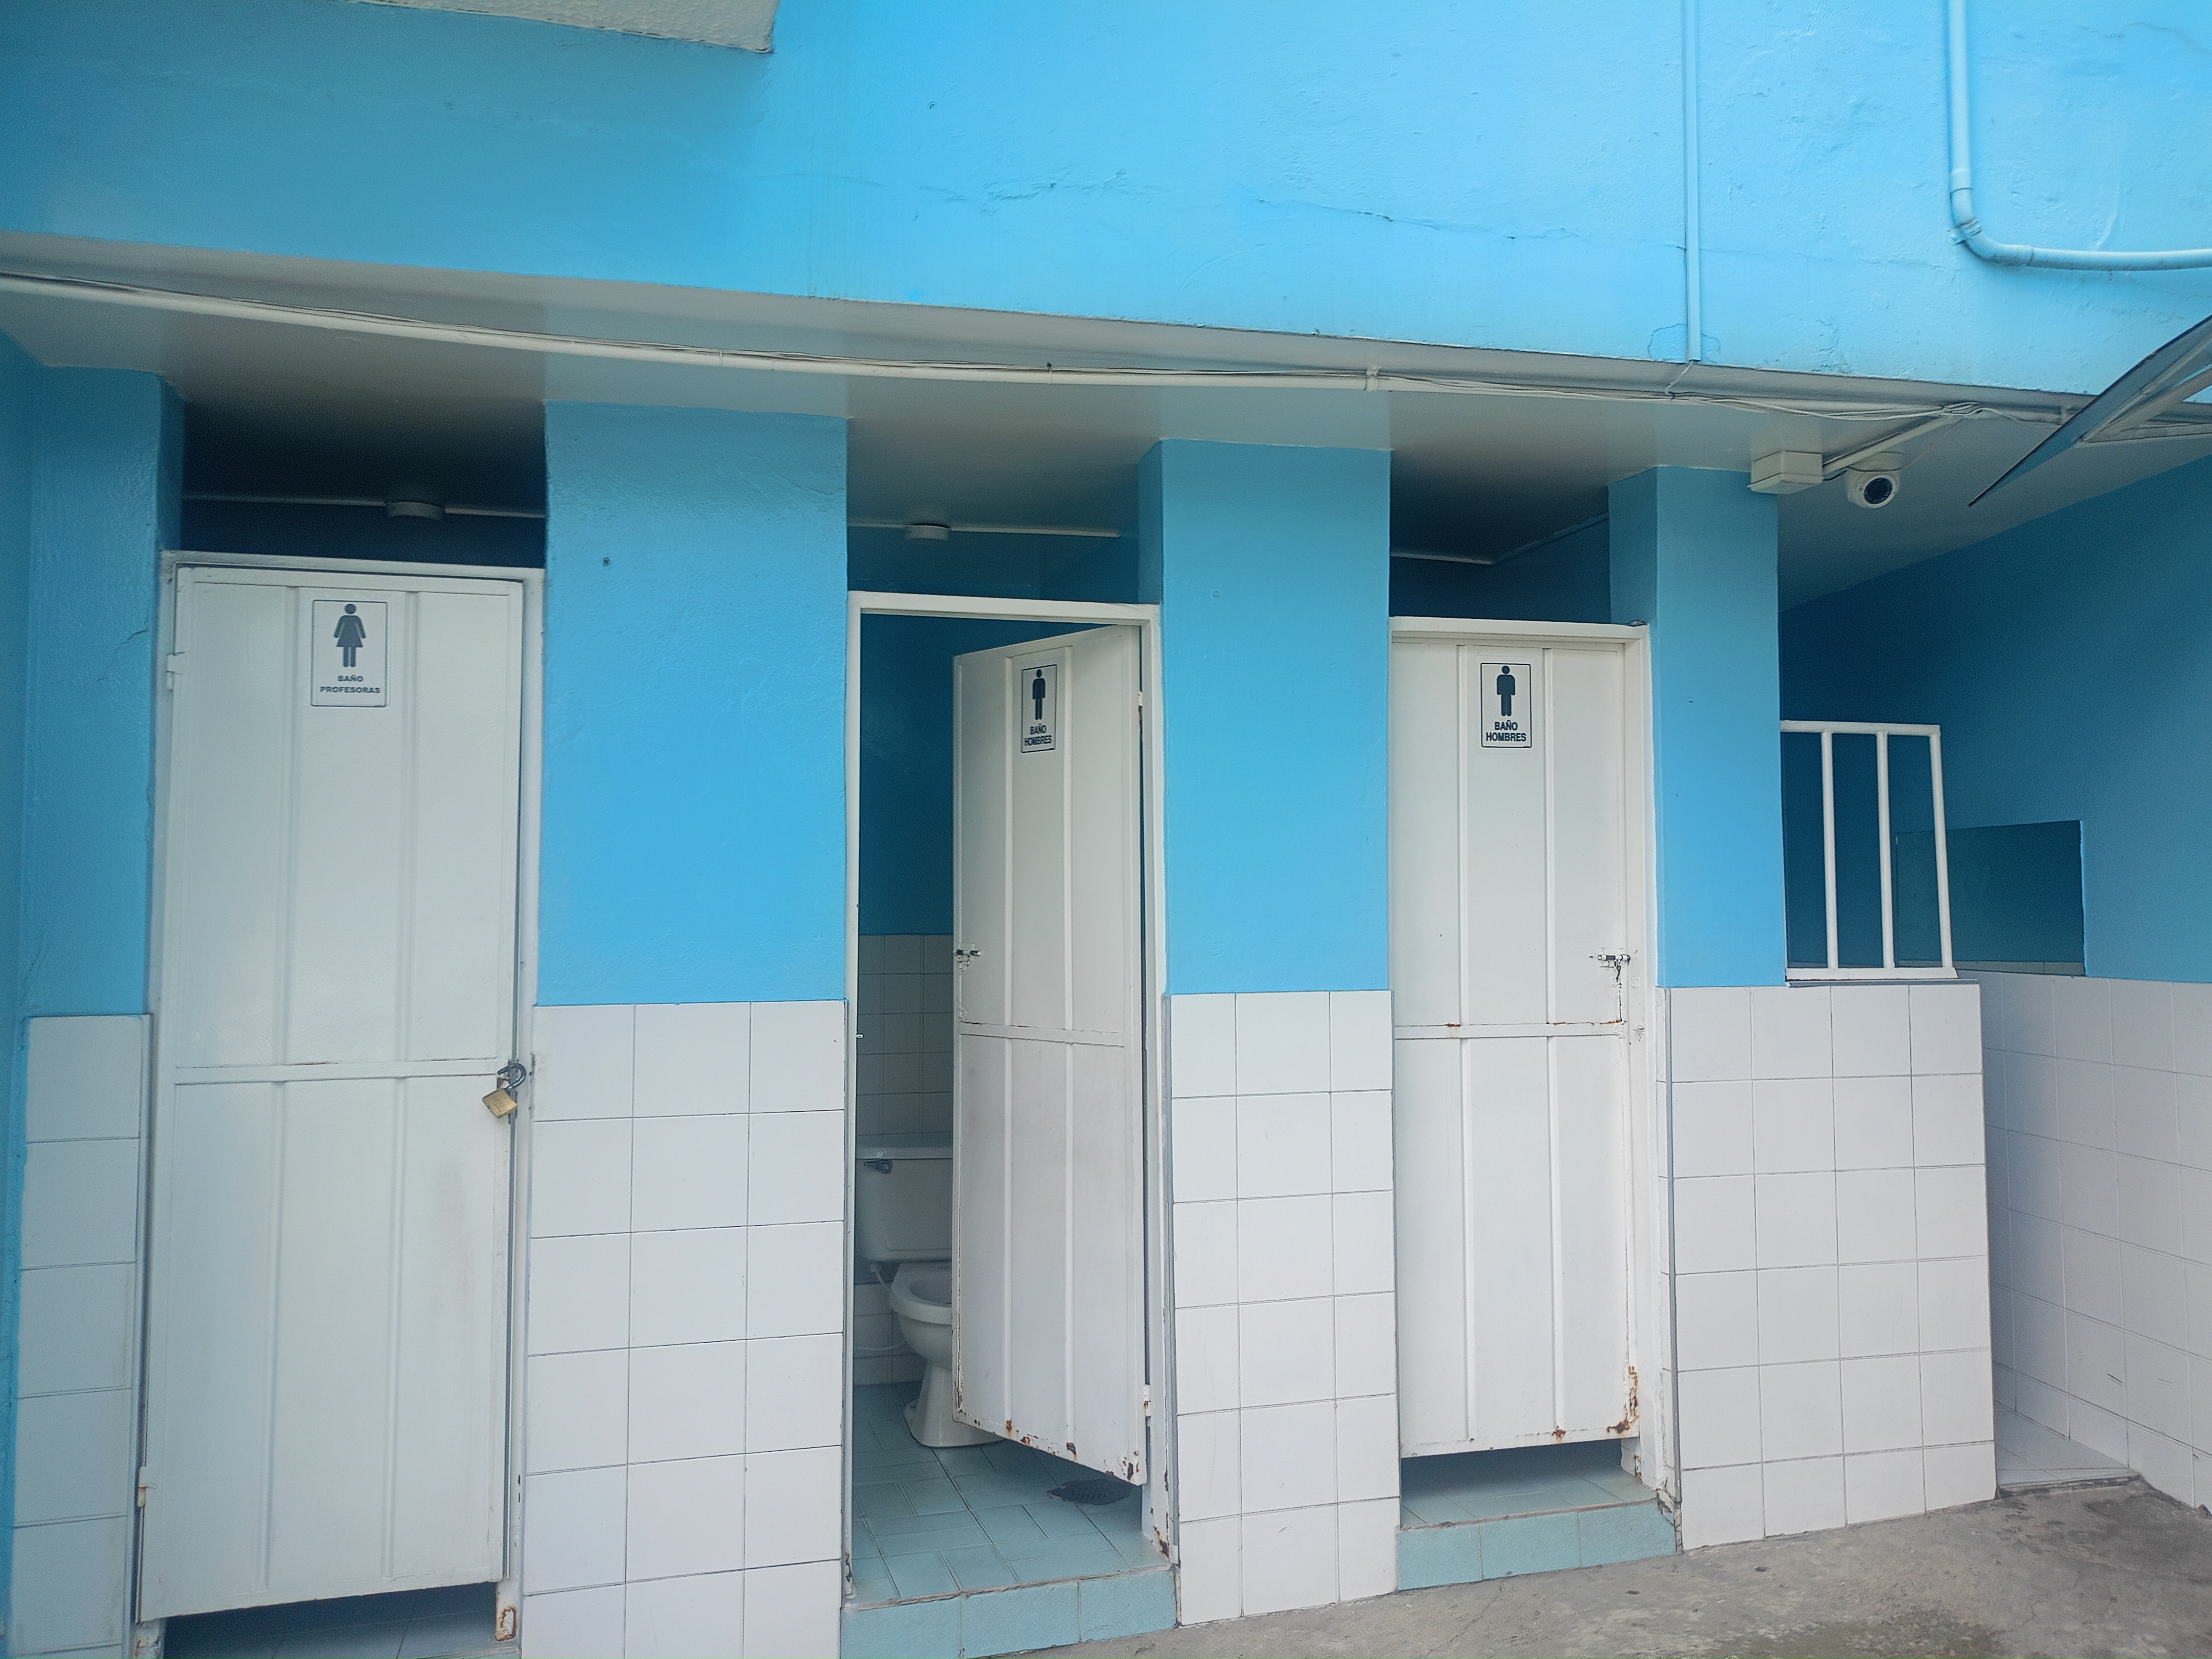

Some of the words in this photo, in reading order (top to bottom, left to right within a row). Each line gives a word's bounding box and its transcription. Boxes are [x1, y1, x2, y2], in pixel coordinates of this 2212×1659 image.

[1030, 723, 1047, 735] BAÑO
[1494, 719, 1518, 730] BAÑO
[1024, 735, 1052, 746] HOMBRES
[1486, 732, 1526, 741] HOMBRES
